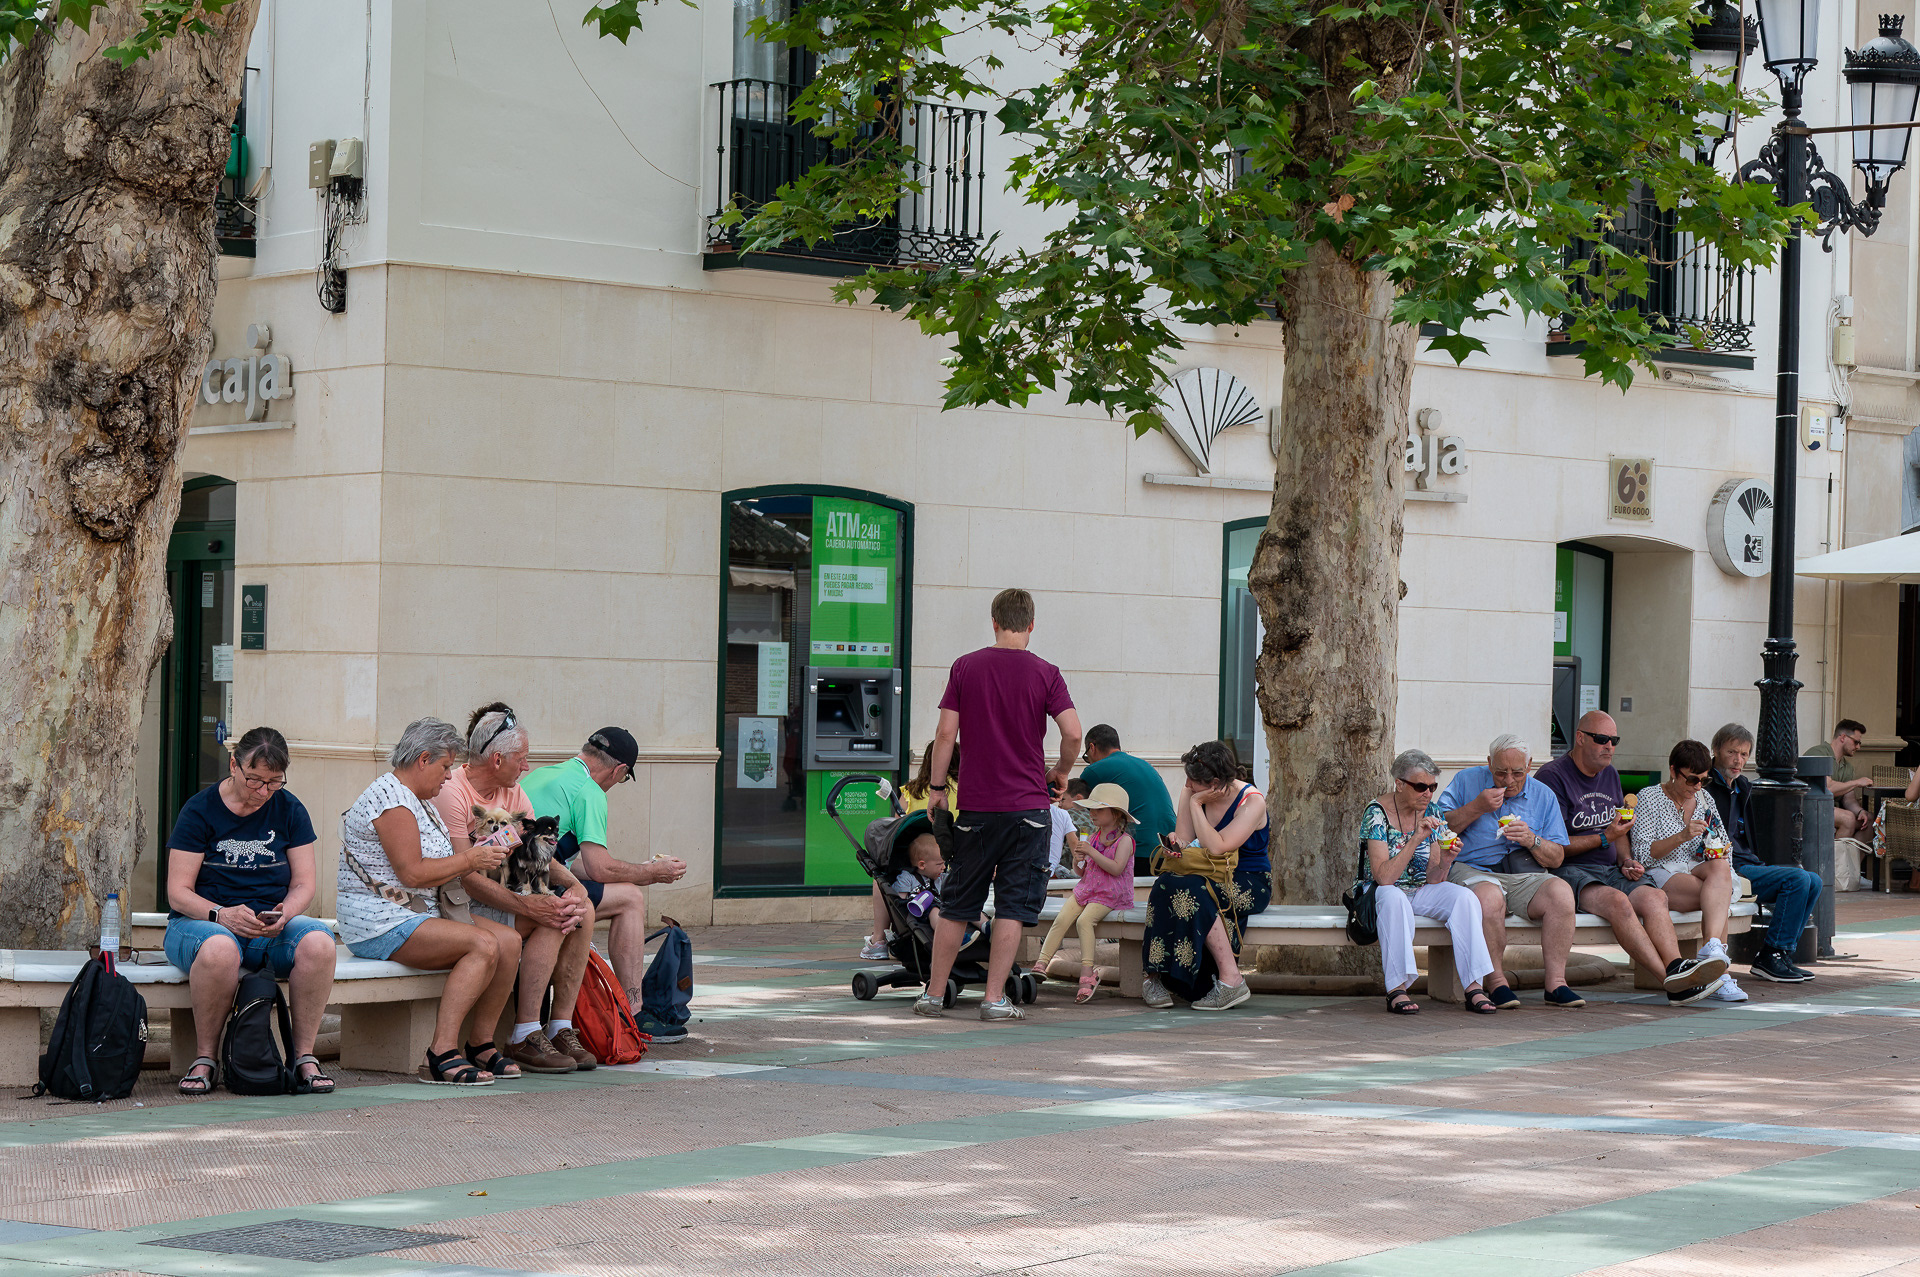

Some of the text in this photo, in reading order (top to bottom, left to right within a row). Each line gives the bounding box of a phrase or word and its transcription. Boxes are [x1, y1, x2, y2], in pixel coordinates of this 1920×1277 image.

[197, 323, 293, 421] caja
[1614, 505, 1650, 516] EURO 6000
[826, 511, 880, 540] ATM 24H
[825, 538, 880, 551] CAJERO AUTOMÁTICO
[824, 572, 858, 581] EN ESTE CAJERO
[824, 580, 873, 590] PUEDES PAGAR RECIBOS
[824, 589, 827, 597] Y
[1572, 806, 1617, 828] Camde
